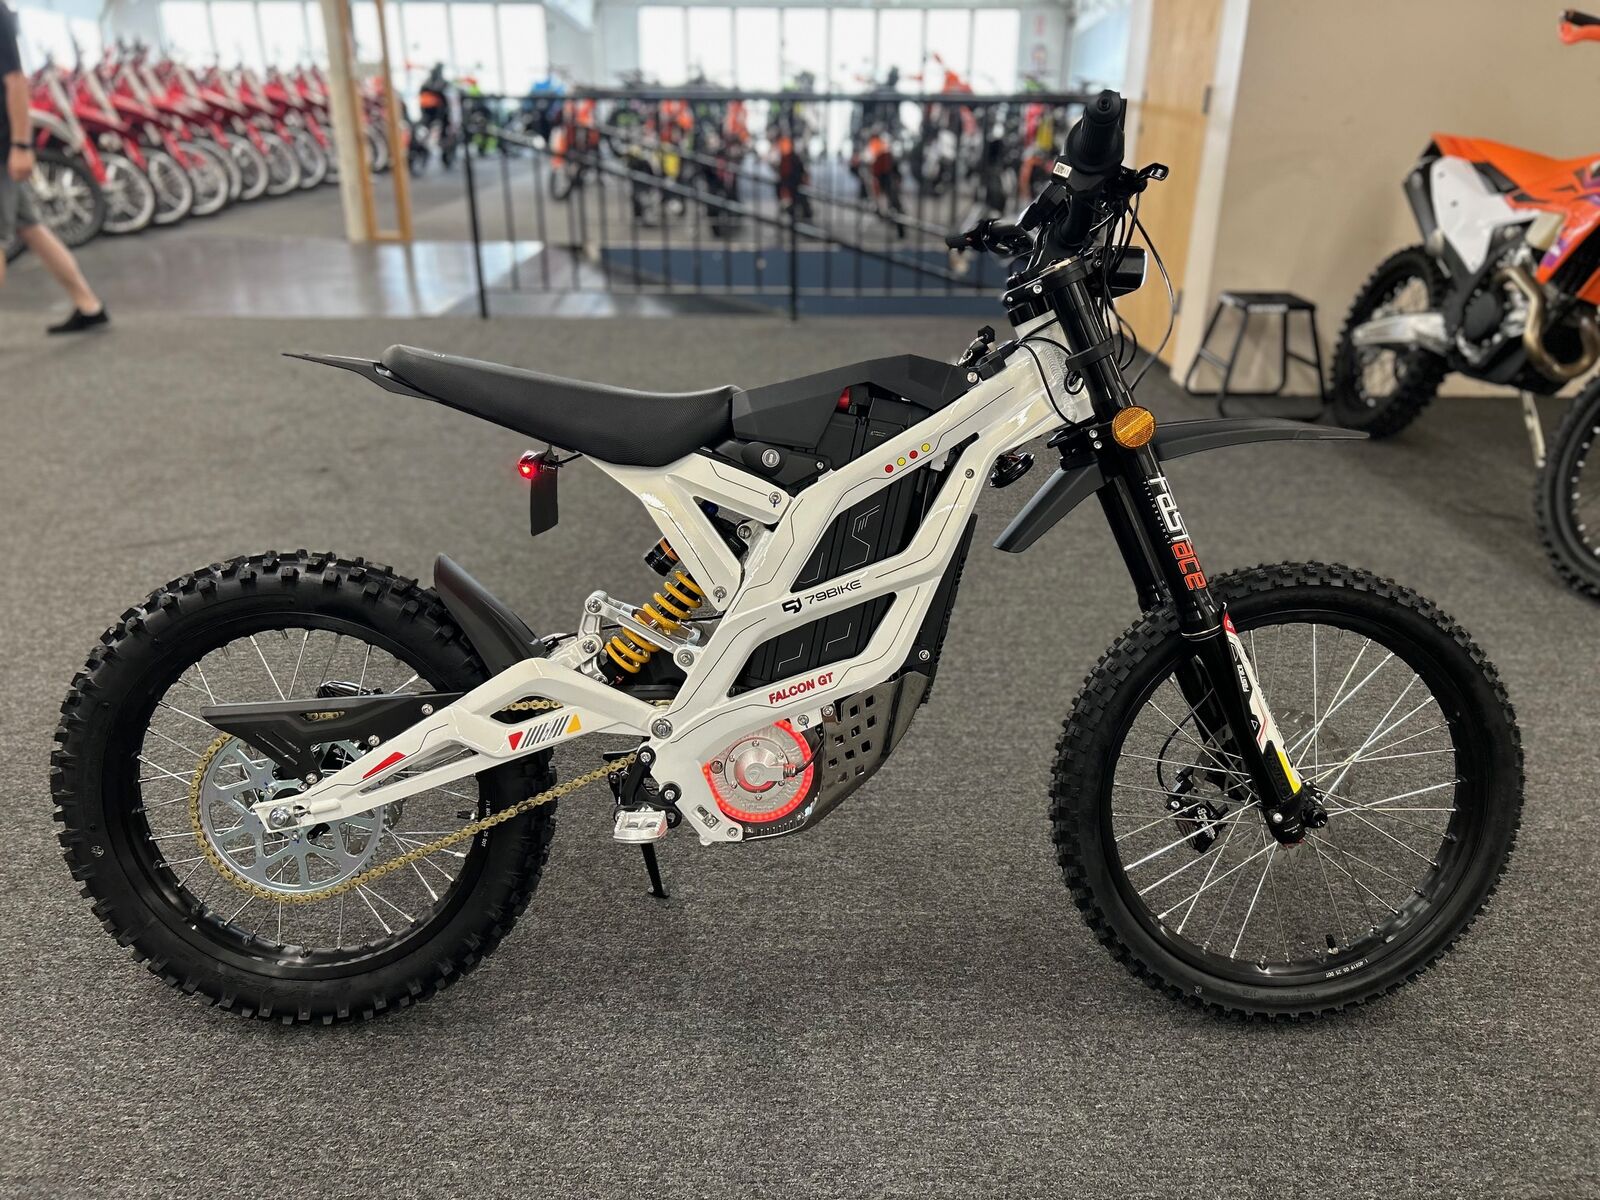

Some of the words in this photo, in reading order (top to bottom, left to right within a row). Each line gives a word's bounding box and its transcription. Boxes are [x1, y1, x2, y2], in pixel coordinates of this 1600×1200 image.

[804, 579, 862, 604] 79BIKE
[768, 678, 815, 704] FALCON
[817, 671, 834, 686] GT
